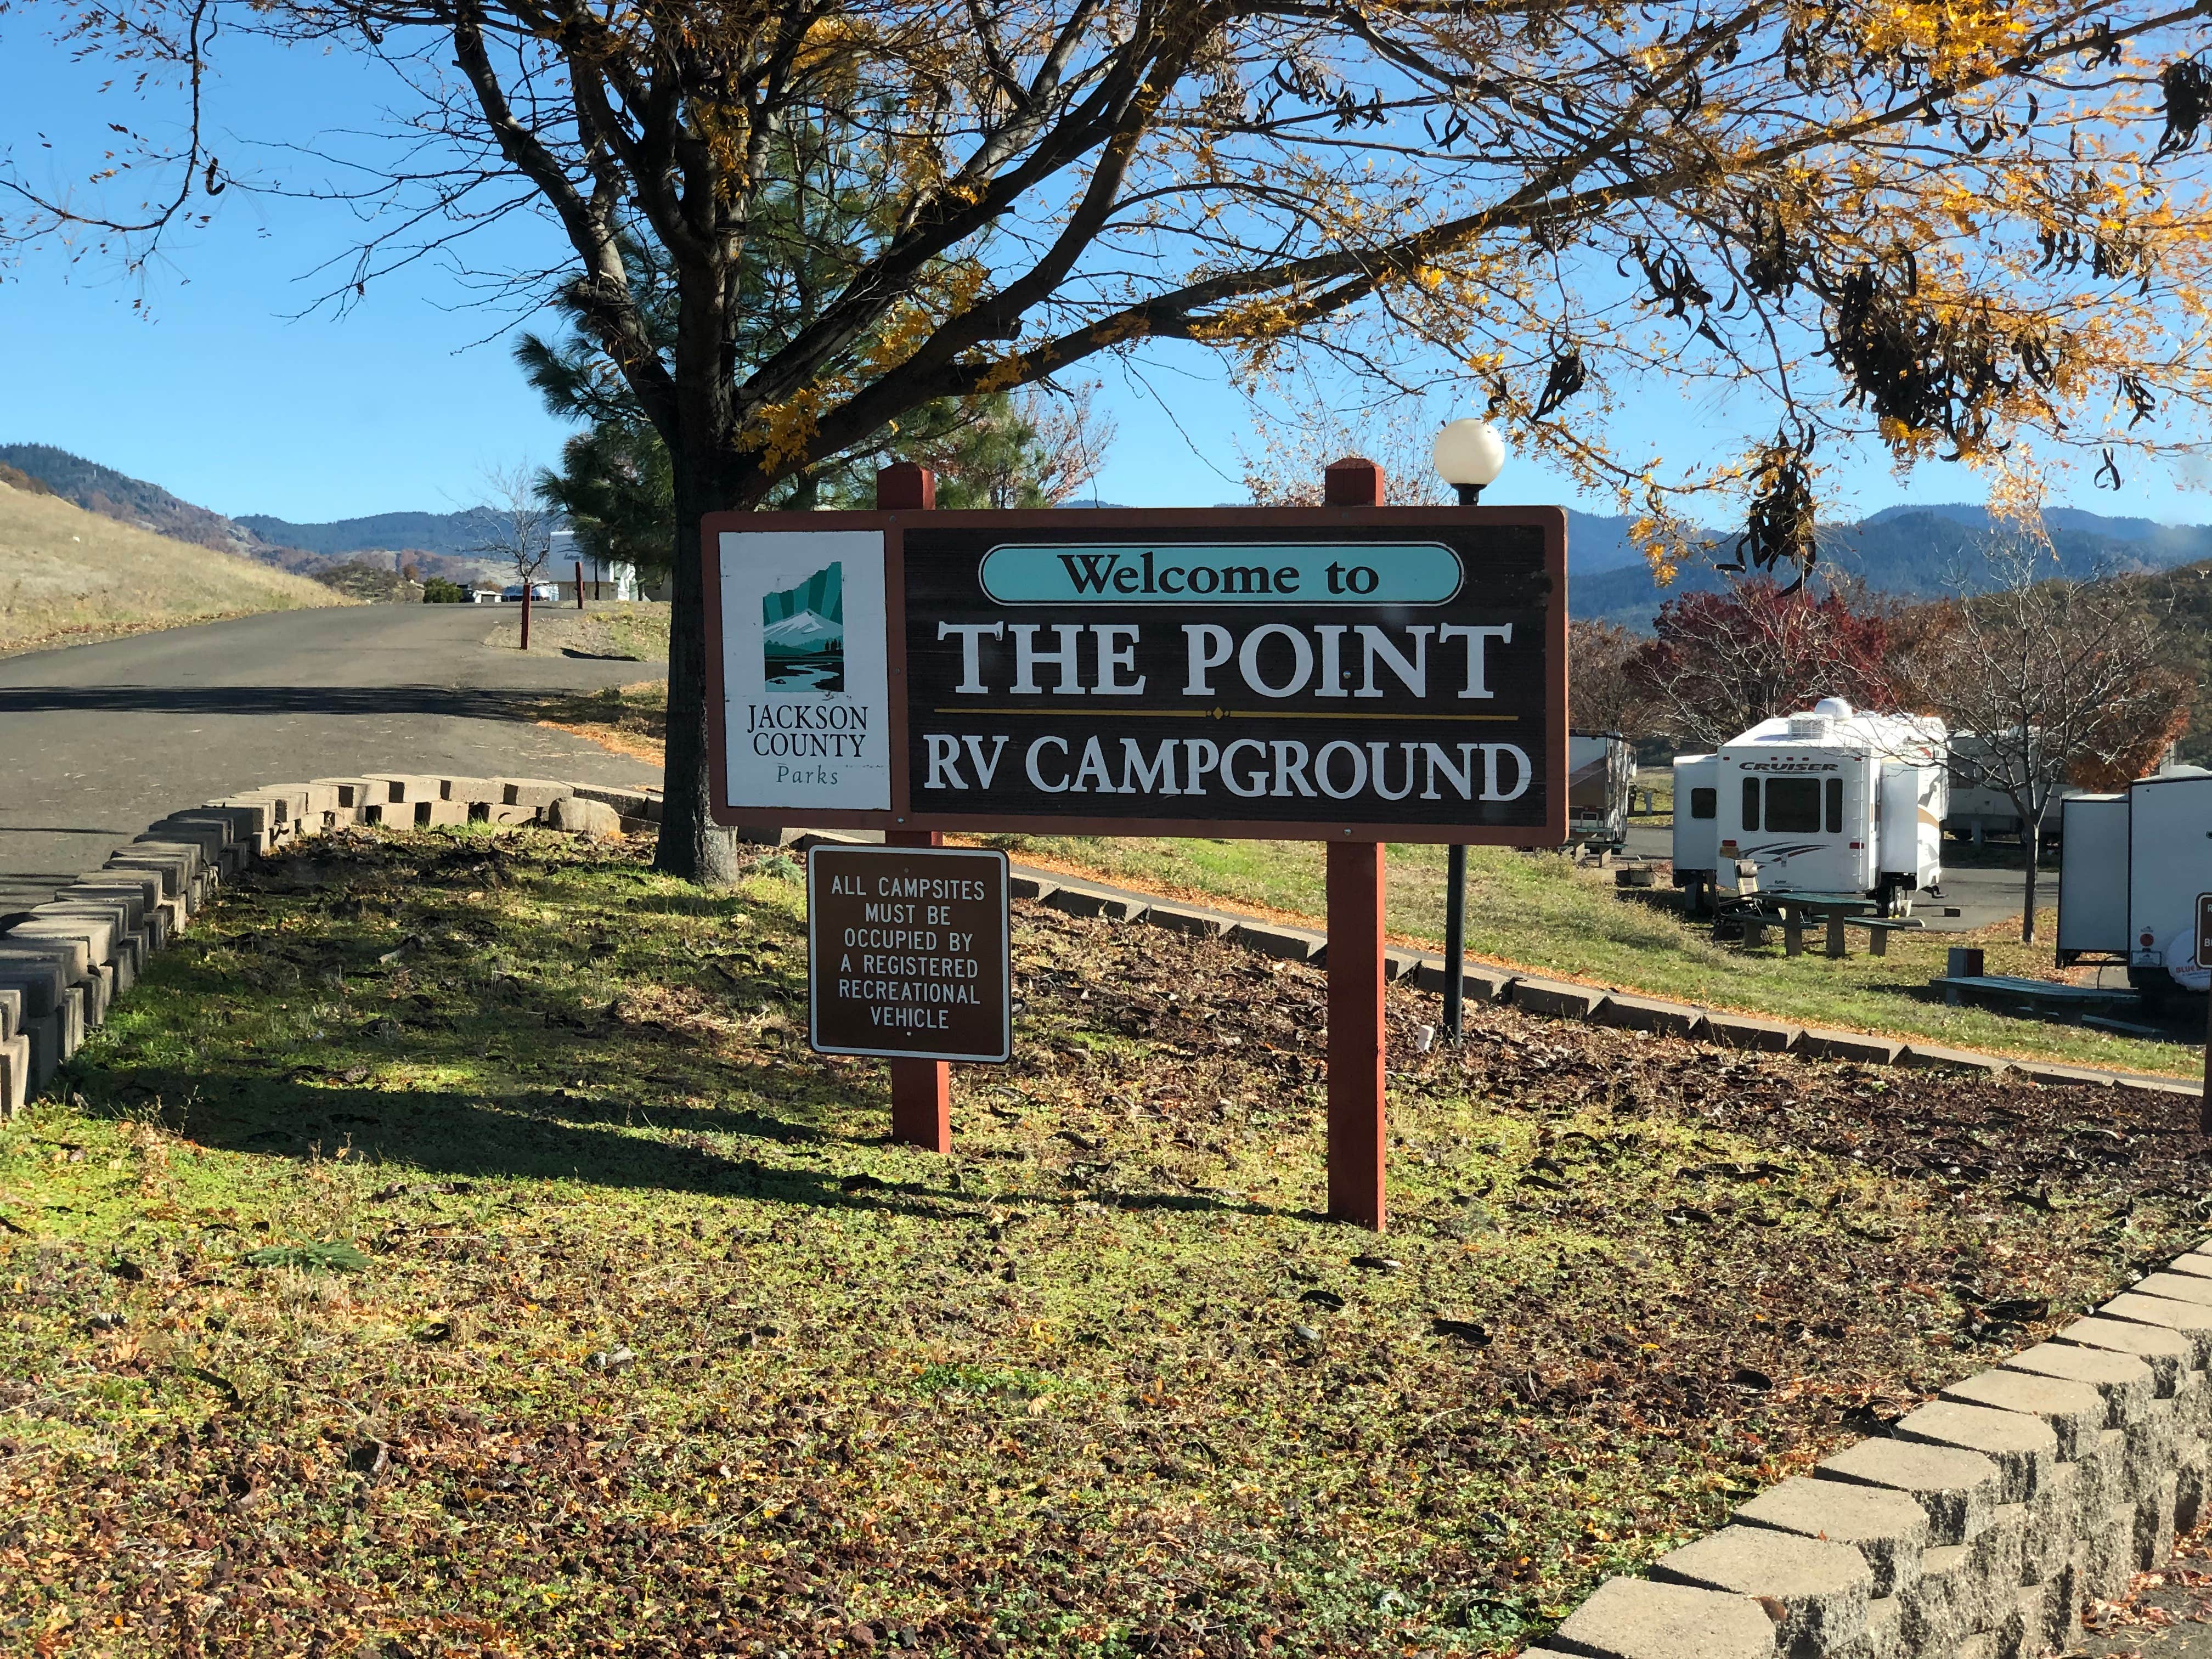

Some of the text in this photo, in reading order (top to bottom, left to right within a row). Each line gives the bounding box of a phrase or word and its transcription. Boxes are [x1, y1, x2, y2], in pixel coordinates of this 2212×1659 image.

[1057, 551, 1379, 594] Welcome to
[938, 621, 1512, 698] THE POINT
[747, 705, 868, 733] JACKSON
[754, 733, 866, 757] COUNTY
[777, 765, 837, 785] Parks
[923, 735, 1532, 801] RV CAMPGROUND
[1739, 762, 1838, 771] CRUISER
[832, 876, 984, 900] ALL CAMPSITES
[866, 903, 950, 925] MUST BE
[845, 928, 973, 951] OCCUPIED BY
[841, 954, 978, 978] A REGISTERED
[839, 979, 980, 1004] RECREATIONAL
[871, 1007, 949, 1029] VEHICLE
